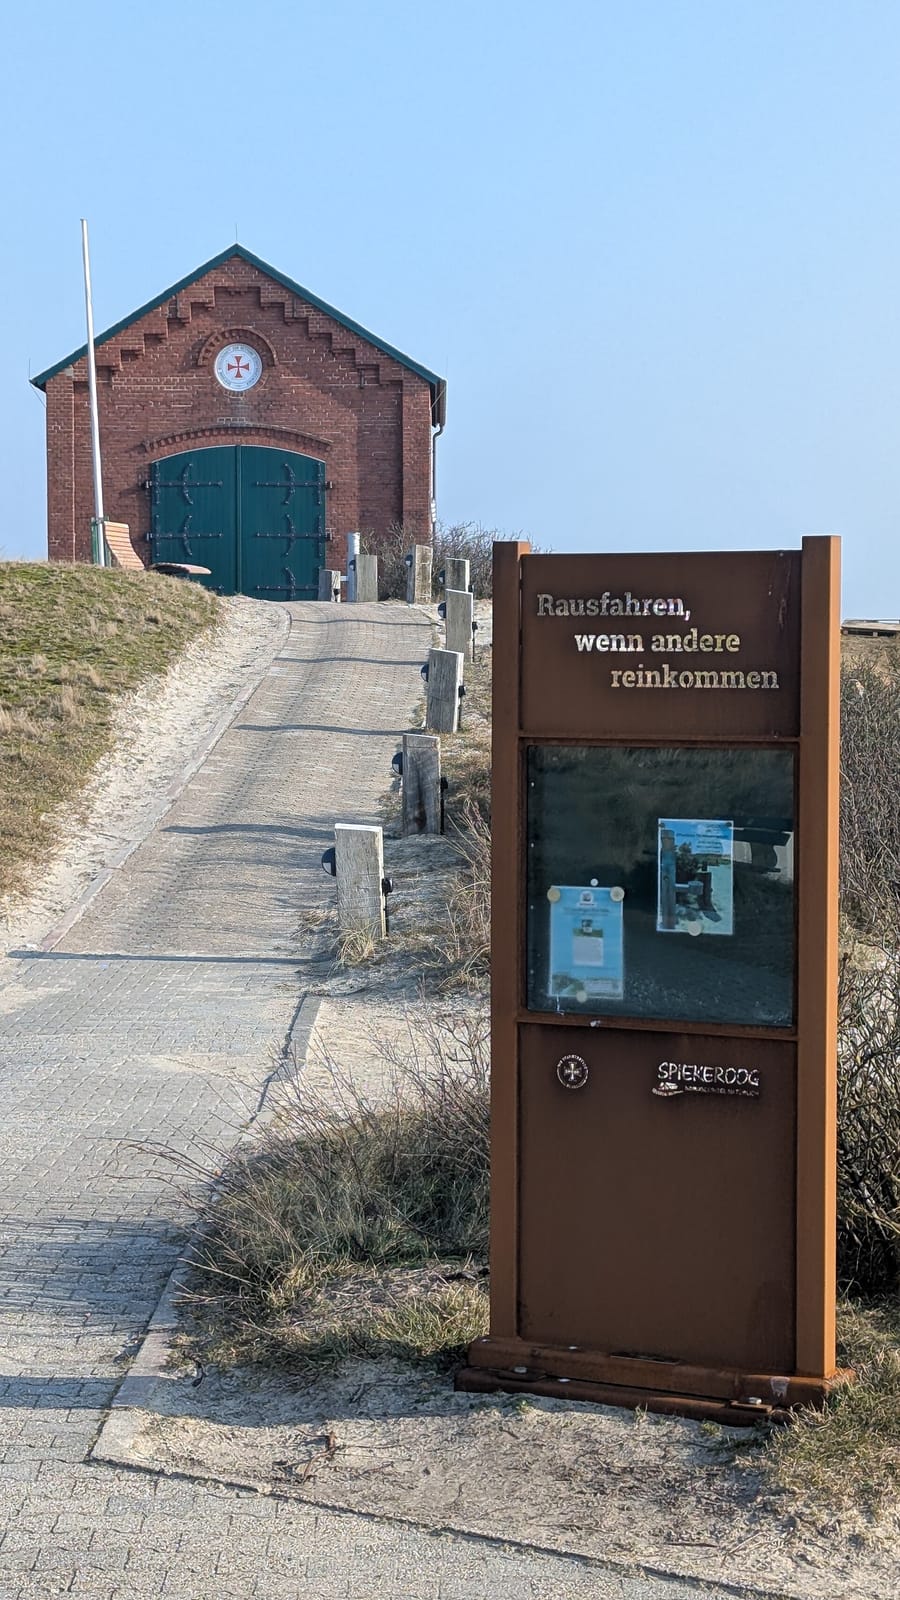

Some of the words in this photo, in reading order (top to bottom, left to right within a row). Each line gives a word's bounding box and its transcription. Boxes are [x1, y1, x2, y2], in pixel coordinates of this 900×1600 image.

[537, 592, 691, 621] Rausfahren,
[574, 634, 645, 652] wenn
[651, 628, 740, 652] andere
[611, 664, 779, 689] reinkommen
